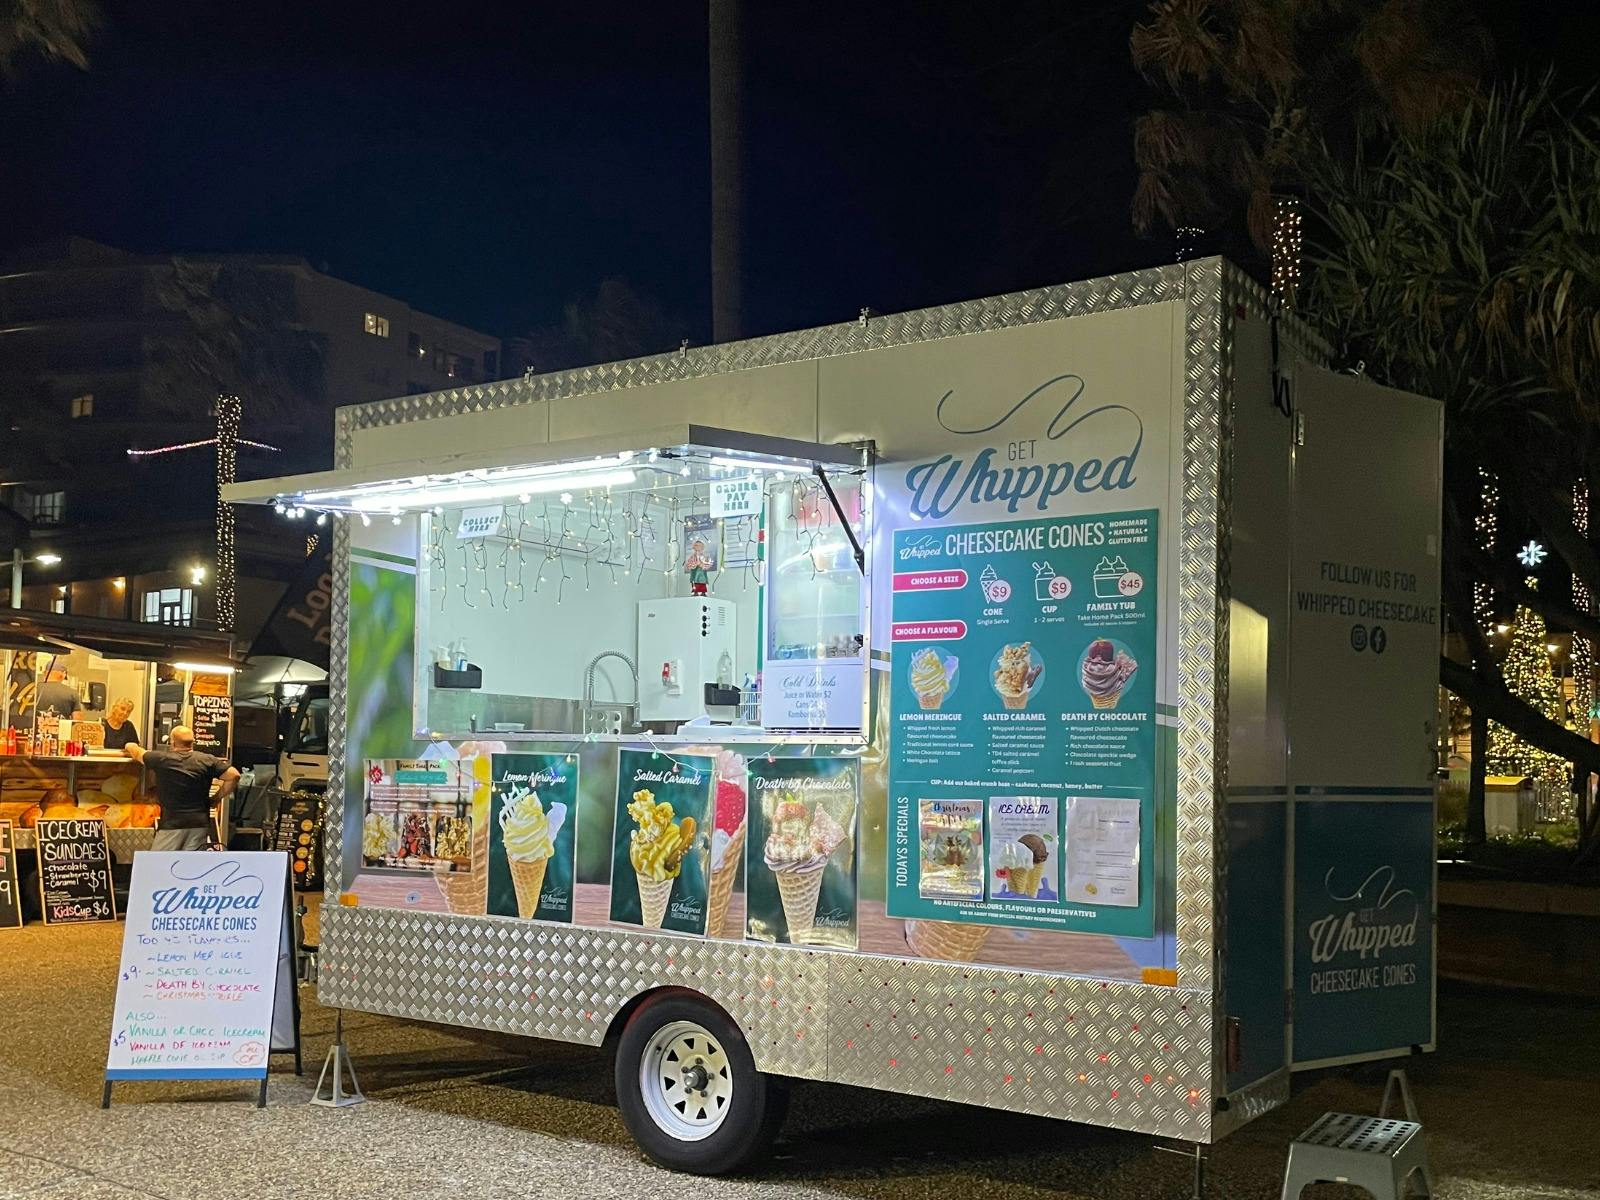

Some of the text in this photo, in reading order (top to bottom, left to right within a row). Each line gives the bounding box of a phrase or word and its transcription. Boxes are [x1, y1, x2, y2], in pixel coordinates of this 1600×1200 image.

[1008, 440, 1037, 461] GET
[905, 442, 1141, 521] Whipped
[727, 492, 746, 502] PAY
[1109, 519, 1148, 527] HOMEMADE
[945, 522, 1104, 556] CHEESECAKE CONES
[1108, 535, 1148, 545] GLUTEN FREE
[911, 577, 937, 585] CHOOSE
[943, 575, 959, 583] SIZE
[1320, 561, 1416, 592] FOLLOW US FOR
[1051, 581, 1067, 594] $9
[1120, 579, 1140, 590] $45
[992, 586, 1007, 599] $9
[983, 608, 1003, 616] CONE
[1042, 605, 1058, 613] CUP
[1087, 602, 1136, 612] FAMILY TUB
[1297, 591, 1436, 625] WHIPPED CHEESECAKE
[927, 626, 958, 634] FLAVOUR
[899, 713, 962, 721] LEMON MERINGUE
[983, 713, 1046, 721] SALTED CARAMEL
[1061, 713, 1147, 721] DEATH BY CHOCOLATE
[502, 770, 529, 781] Lemon
[633, 768, 701, 786] Salted Caramel
[755, 776, 786, 790] Death
[998, 804, 1050, 814] ICE CREM
[896, 796, 909, 888] TODAYS SPECIALS
[88, 869, 108, 893] $9
[203, 885, 218, 894] GET
[152, 886, 263, 915] Whipped
[93, 900, 110, 916] $6
[151, 917, 257, 931] CHEESECAKE CONES
[1309, 909, 1418, 964] Whipped
[156, 979, 187, 990] DEATH
[191, 980, 205, 990] BY
[1311, 963, 1416, 995] CHEESECAKE CONES
[129, 1024, 167, 1038] VANILLA
[129, 1041, 166, 1051] VANILLA
